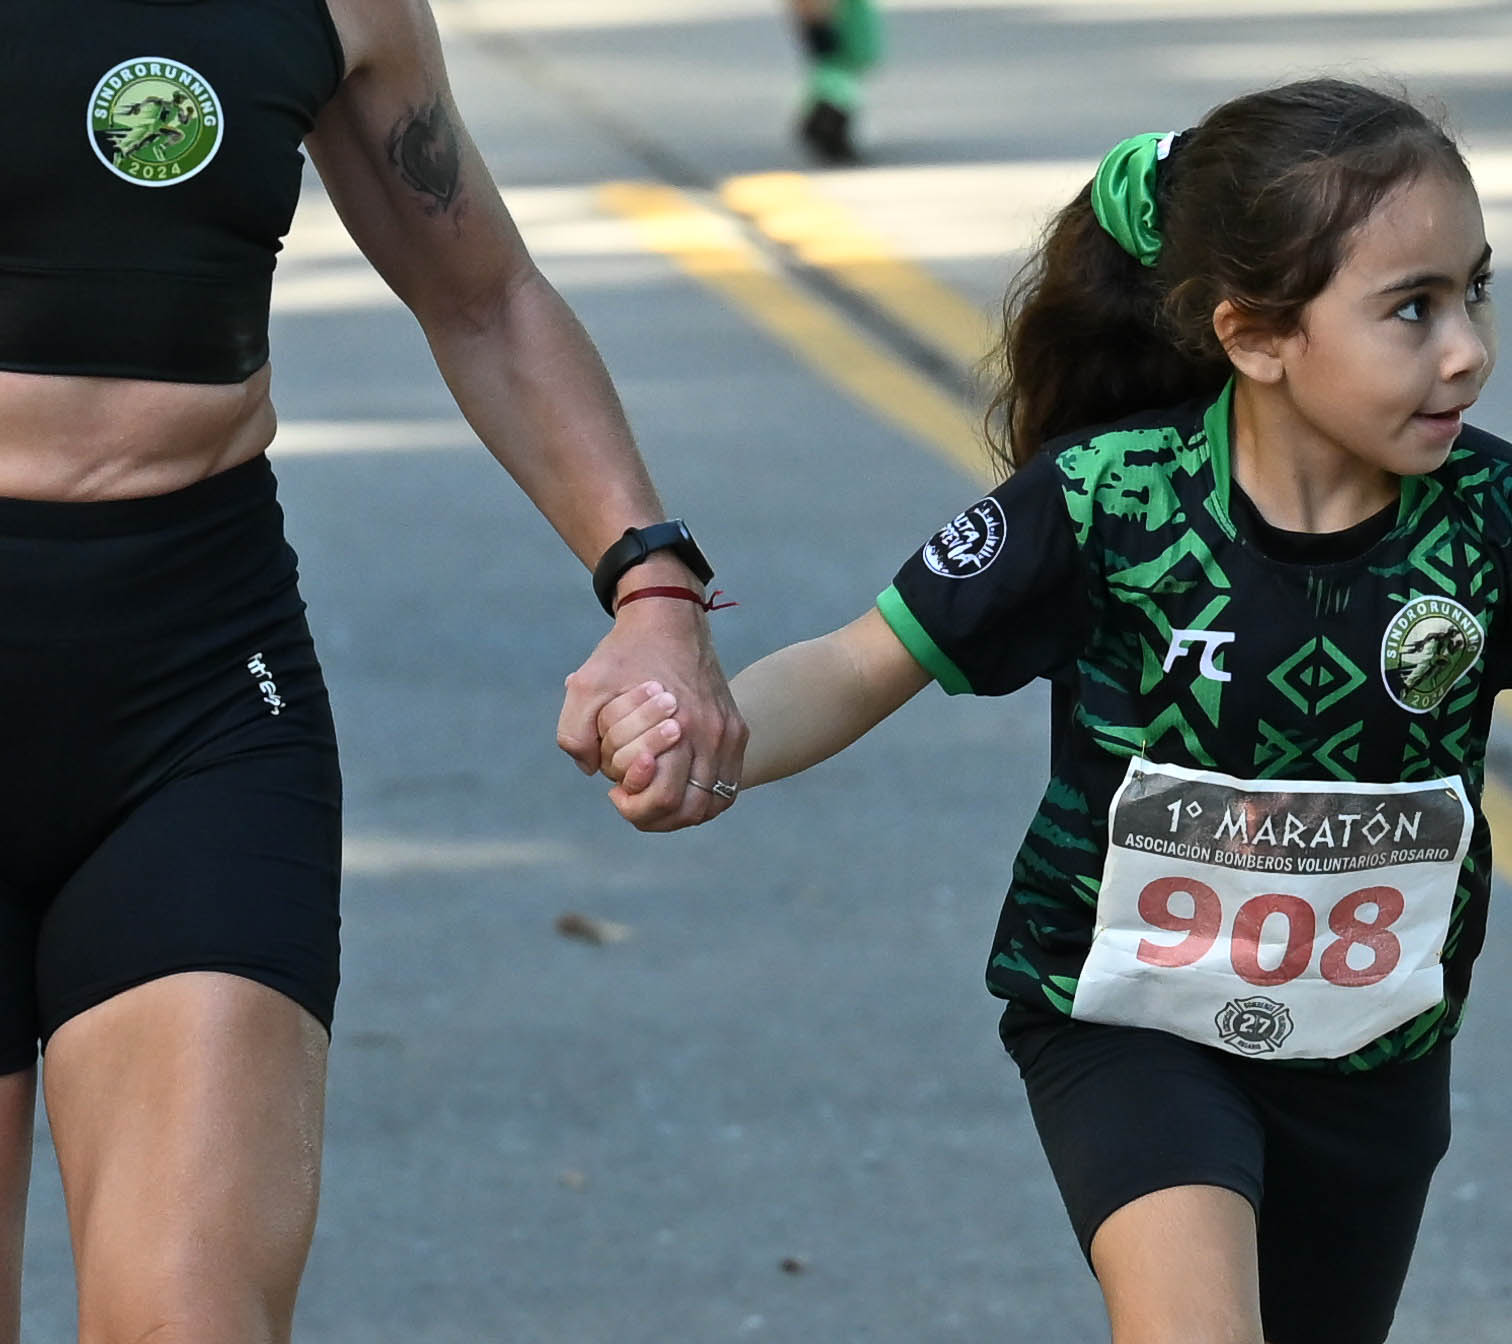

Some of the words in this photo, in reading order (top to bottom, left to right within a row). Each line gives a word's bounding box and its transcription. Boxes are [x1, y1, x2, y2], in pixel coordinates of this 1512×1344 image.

[94, 63, 217, 127] SINDRORUNNING
[129, 162, 181, 178] 2024
[1213, 802, 1422, 849] MARATÓN
[1125, 833, 1211, 862] ASOCIACIÓN
[1215, 850, 1293, 872] BOMBEROS
[1297, 852, 1386, 872] VOLUNTARIOS
[1390, 848, 1450, 864] ROSARIO
[1136, 876, 1405, 987] 908
[1239, 1013, 1272, 1034] 27
